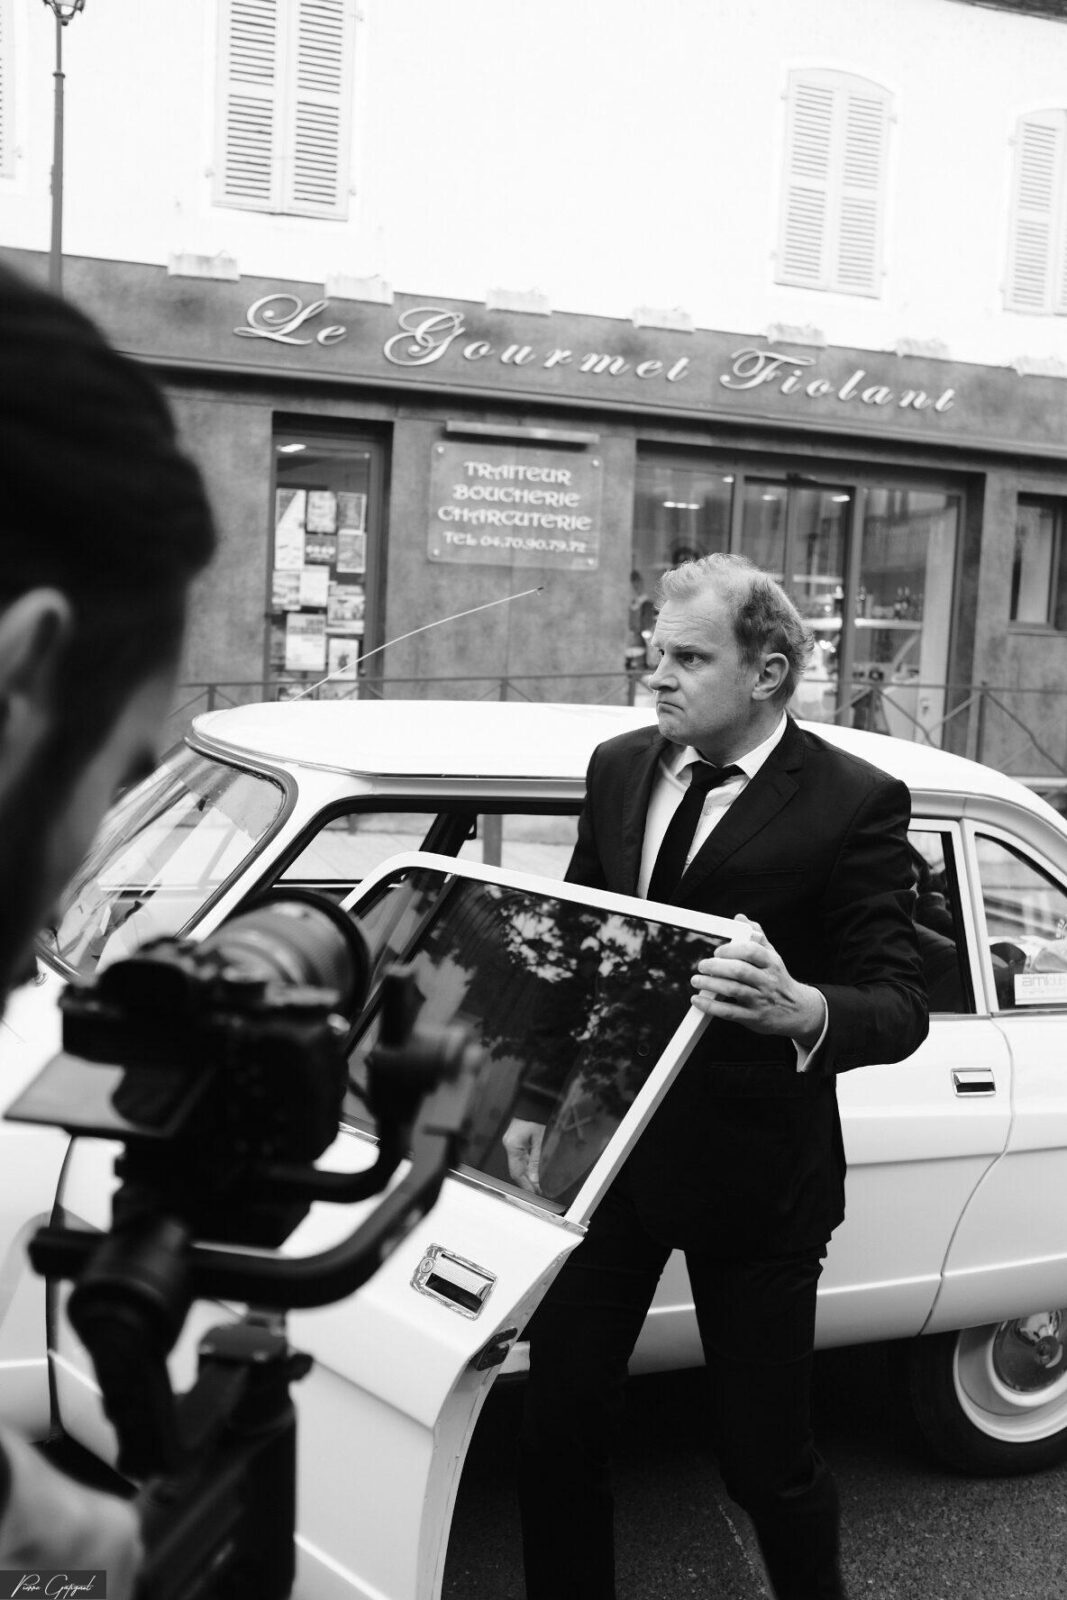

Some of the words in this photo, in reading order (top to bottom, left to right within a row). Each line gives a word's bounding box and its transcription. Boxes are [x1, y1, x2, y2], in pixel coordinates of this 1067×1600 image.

[233, 293, 347, 345] Le
[383, 306, 689, 382] Gourmet
[720, 348, 956, 412] Fiolant
[464, 461, 573, 486] TRAITEUR
[452, 484, 581, 508] BOUCHERIE
[437, 505, 593, 531] CHARCUTERIE
